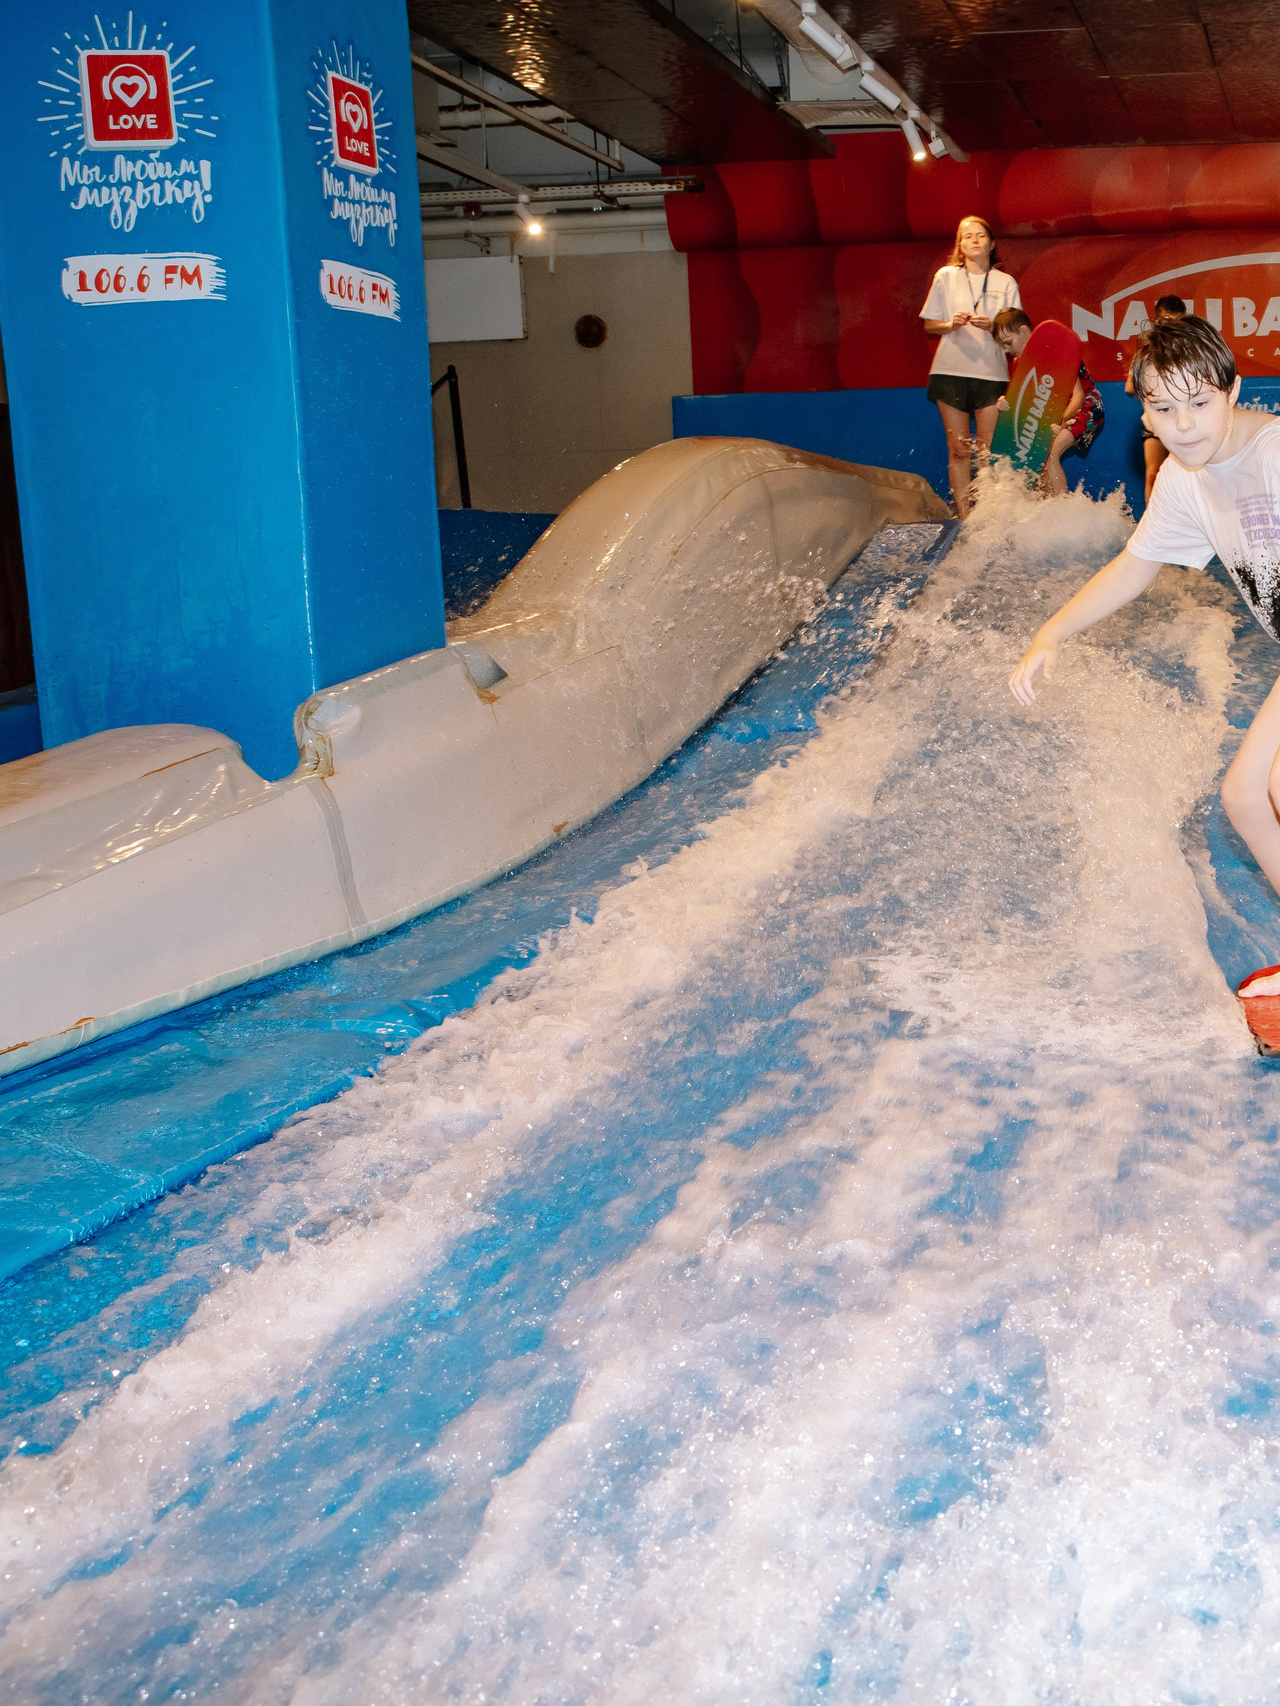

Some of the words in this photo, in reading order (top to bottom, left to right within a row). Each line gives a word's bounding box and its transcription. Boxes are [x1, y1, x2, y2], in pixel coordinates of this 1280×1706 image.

[108, 114, 158, 130] LOVE
[345, 135, 371, 157] LOVE
[60, 156, 107, 191] Мы
[322, 167, 348, 199] Мы
[73, 265, 151, 294] 106.6
[164, 264, 203, 291] FM
[327, 272, 366, 304] 106.6
[371, 282, 391, 310] FM
